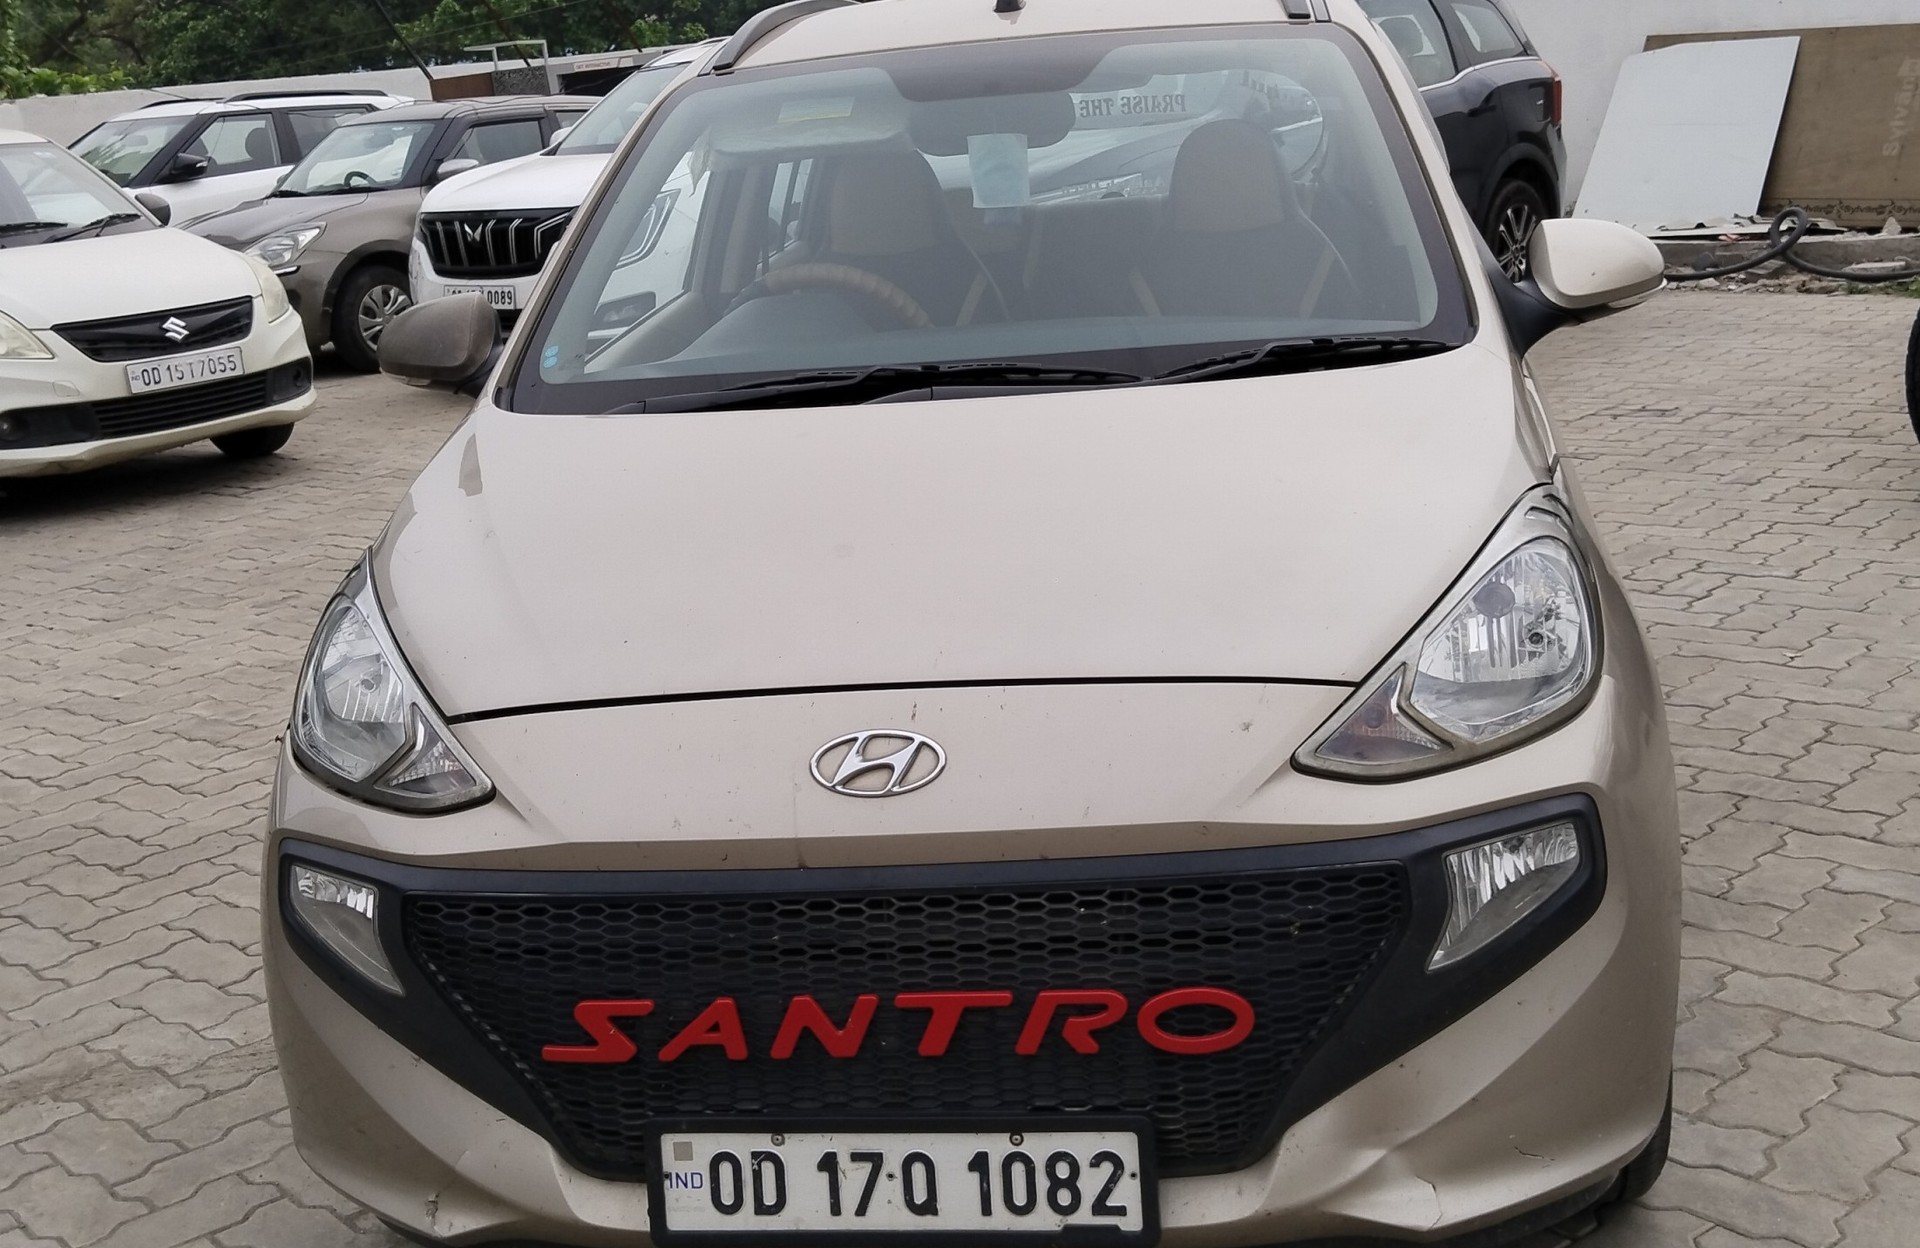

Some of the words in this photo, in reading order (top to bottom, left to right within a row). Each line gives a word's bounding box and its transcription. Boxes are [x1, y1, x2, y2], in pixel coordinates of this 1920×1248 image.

[487, 290, 513, 305] 0089
[542, 986, 1256, 1064] SANTRO
[668, 1171, 704, 1190] IND
[709, 1150, 787, 1216] OD
[967, 1150, 1128, 1217] 1082
